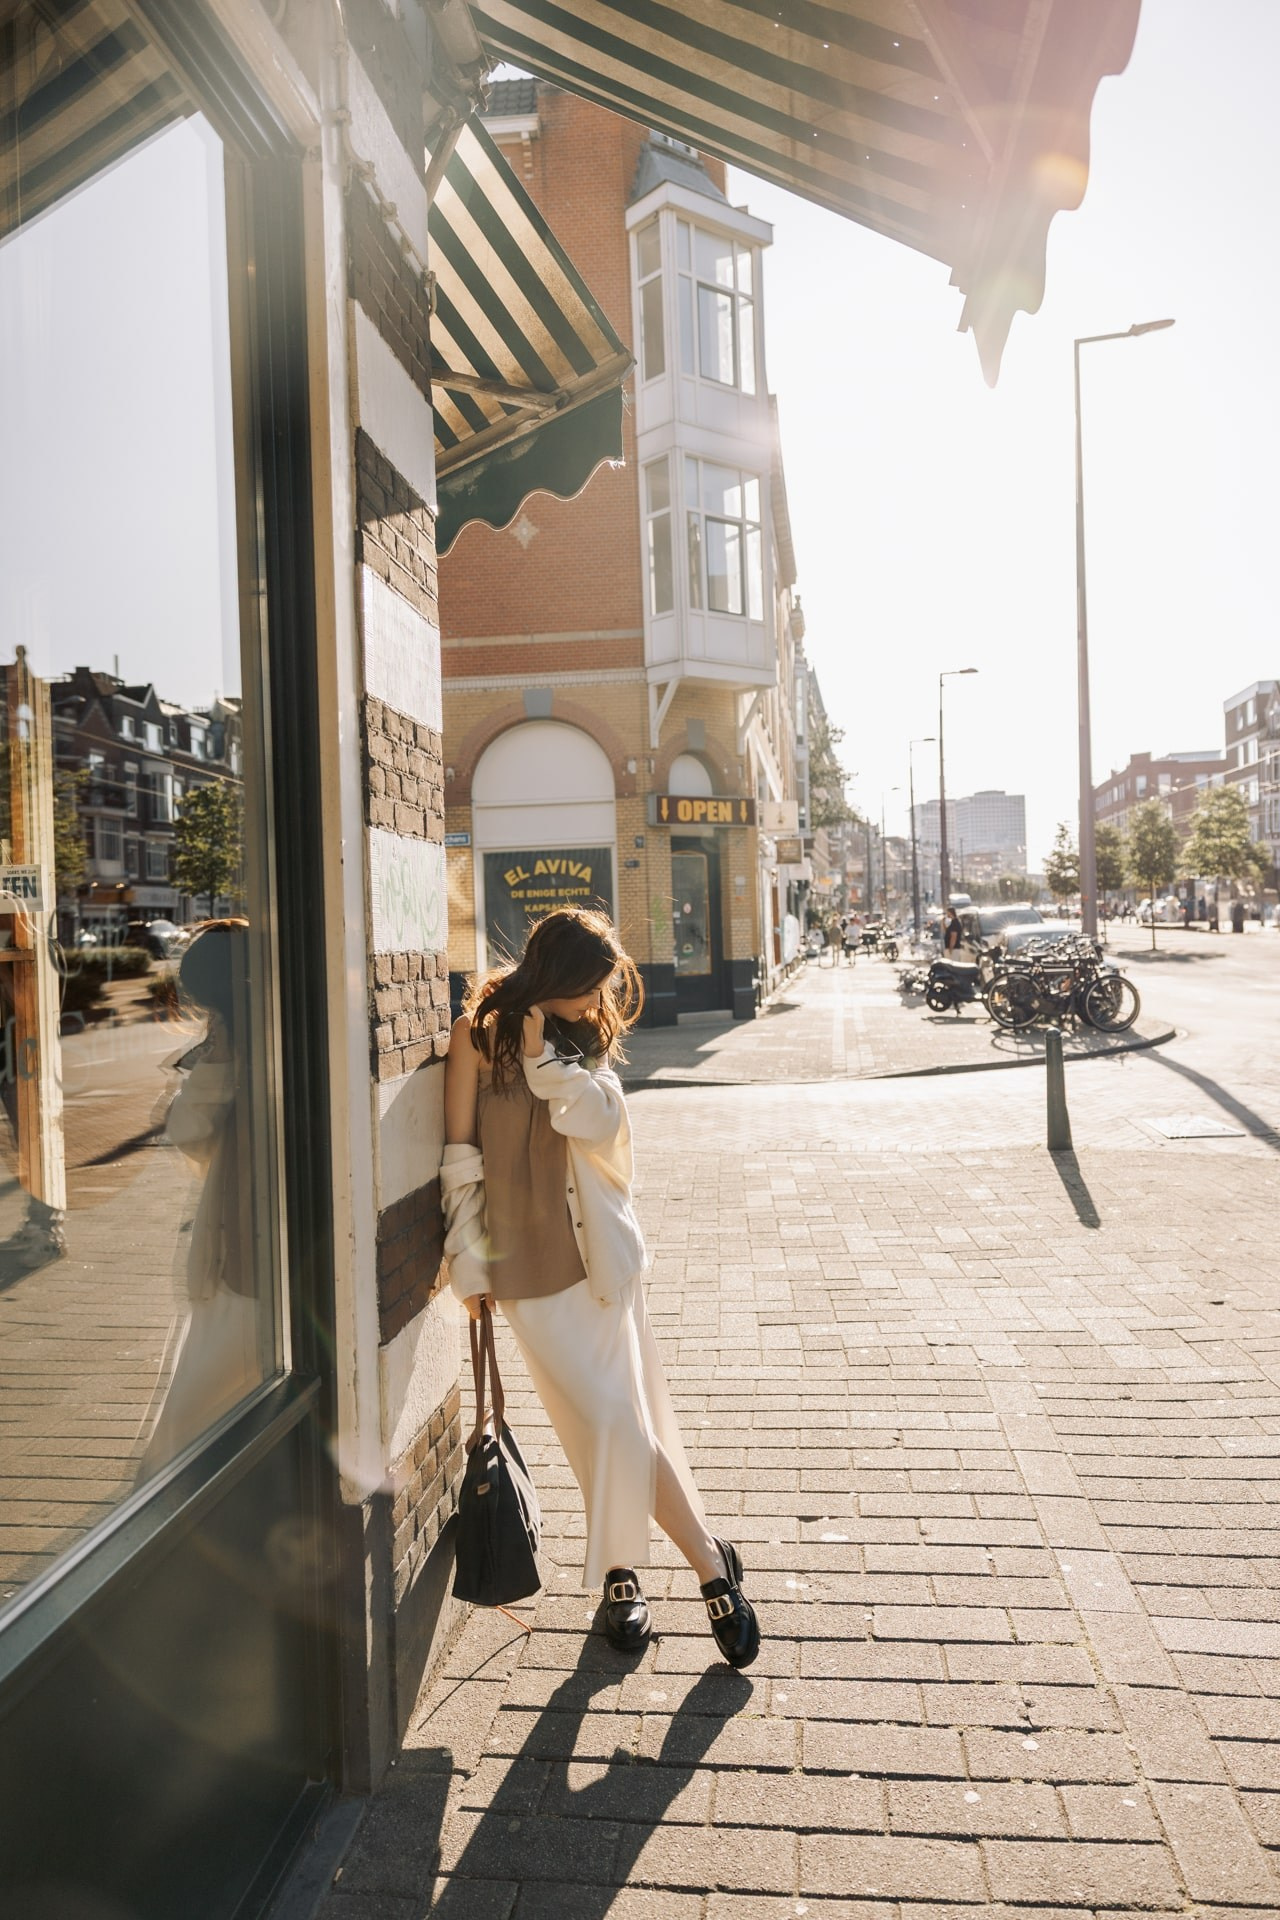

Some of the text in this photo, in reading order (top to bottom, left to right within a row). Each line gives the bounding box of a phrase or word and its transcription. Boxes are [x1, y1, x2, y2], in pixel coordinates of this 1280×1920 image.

[678, 800, 732, 822] OPEN
[504, 859, 593, 886] EL AVIVA
[3, 876, 37, 899] TEN
[511, 887, 590, 898] DE ENIGE ECHTE
[524, 902, 579, 913] KAPSA
